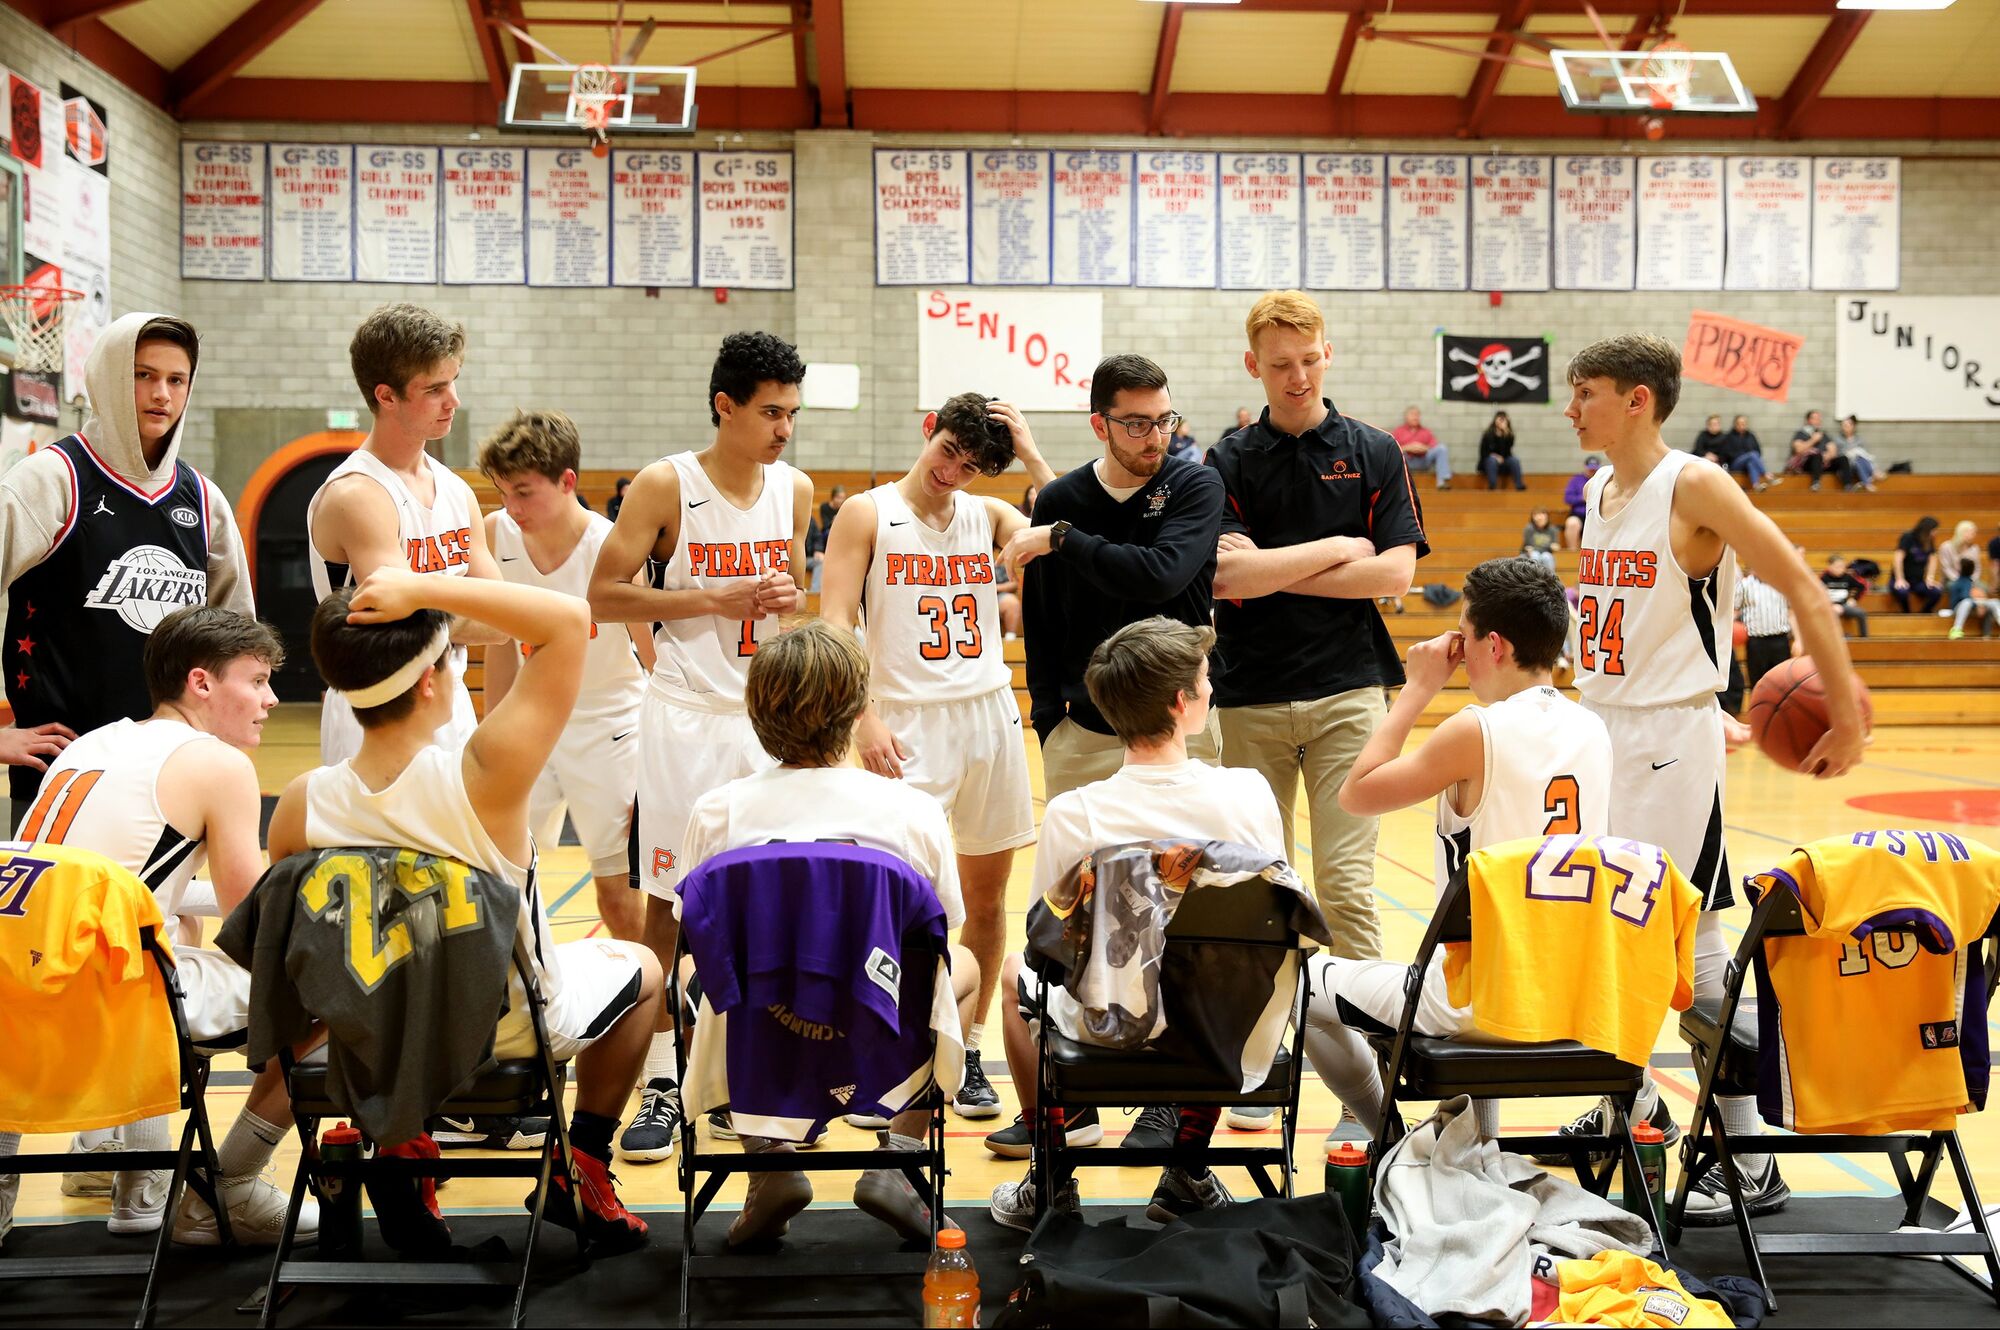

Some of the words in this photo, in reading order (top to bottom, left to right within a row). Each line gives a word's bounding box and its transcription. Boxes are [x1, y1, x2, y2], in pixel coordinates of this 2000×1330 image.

[275, 167, 301, 178] BOYS
[312, 168, 348, 180] TENNIS
[360, 171, 391, 183] GIRLS
[401, 172, 433, 184] TRACK
[445, 170, 468, 182] GIRLS
[472, 170, 520, 182] BASKETBALL
[614, 173, 637, 185] GIRLS
[641, 173, 691, 186] BASKETBALL
[905, 171, 939, 184] BOYS
[195, 179, 252, 191] CHAMPIONS
[283, 183, 340, 194] CHAMPIONS
[455, 184, 512, 196] CHAMPIONS
[703, 181, 734, 194] BOYS
[744, 181, 789, 194] TENNIS
[880, 185, 963, 197] VOLLEYBALL
[1064, 185, 1120, 197] CHAMPIONS
[368, 188, 425, 200] CHAMPIONS
[624, 188, 682, 199] CHAMPIONS
[1148, 187, 1205, 199] CHAMPIONS
[1232, 190, 1289, 201] CHAMPIONS
[1316, 190, 1372, 201] CHAMPIONS
[1401, 191, 1455, 203] CHAMPIONS
[1487, 191, 1536, 201] CHAMPIONS
[1559, 188, 1585, 200] GIRLS
[1595, 188, 1631, 200] SOCCER
[705, 199, 786, 212] CHAMPIONS
[883, 199, 960, 210] CHAMPIONS
[1566, 202, 1623, 213] CHAMPIONS
[730, 216, 764, 229] 1995
[177, 511, 195, 523] KIA
[136, 566, 157, 575] LOS
[159, 570, 205, 581] ANGELES
[886, 553, 994, 586] PIRATES
[1579, 548, 1657, 588] IRATES
[93, 564, 204, 607] LAKERS
[918, 593, 982, 661] 33
[1580, 595, 1625, 676] 24
[20, 768, 105, 845] 11
[1543, 774, 1581, 835] 2
[1852, 830, 1971, 863] NASH
[652, 846, 676, 878] P
[830, 1084, 856, 1095] adidas
[1533, 1255, 1553, 1278] R
